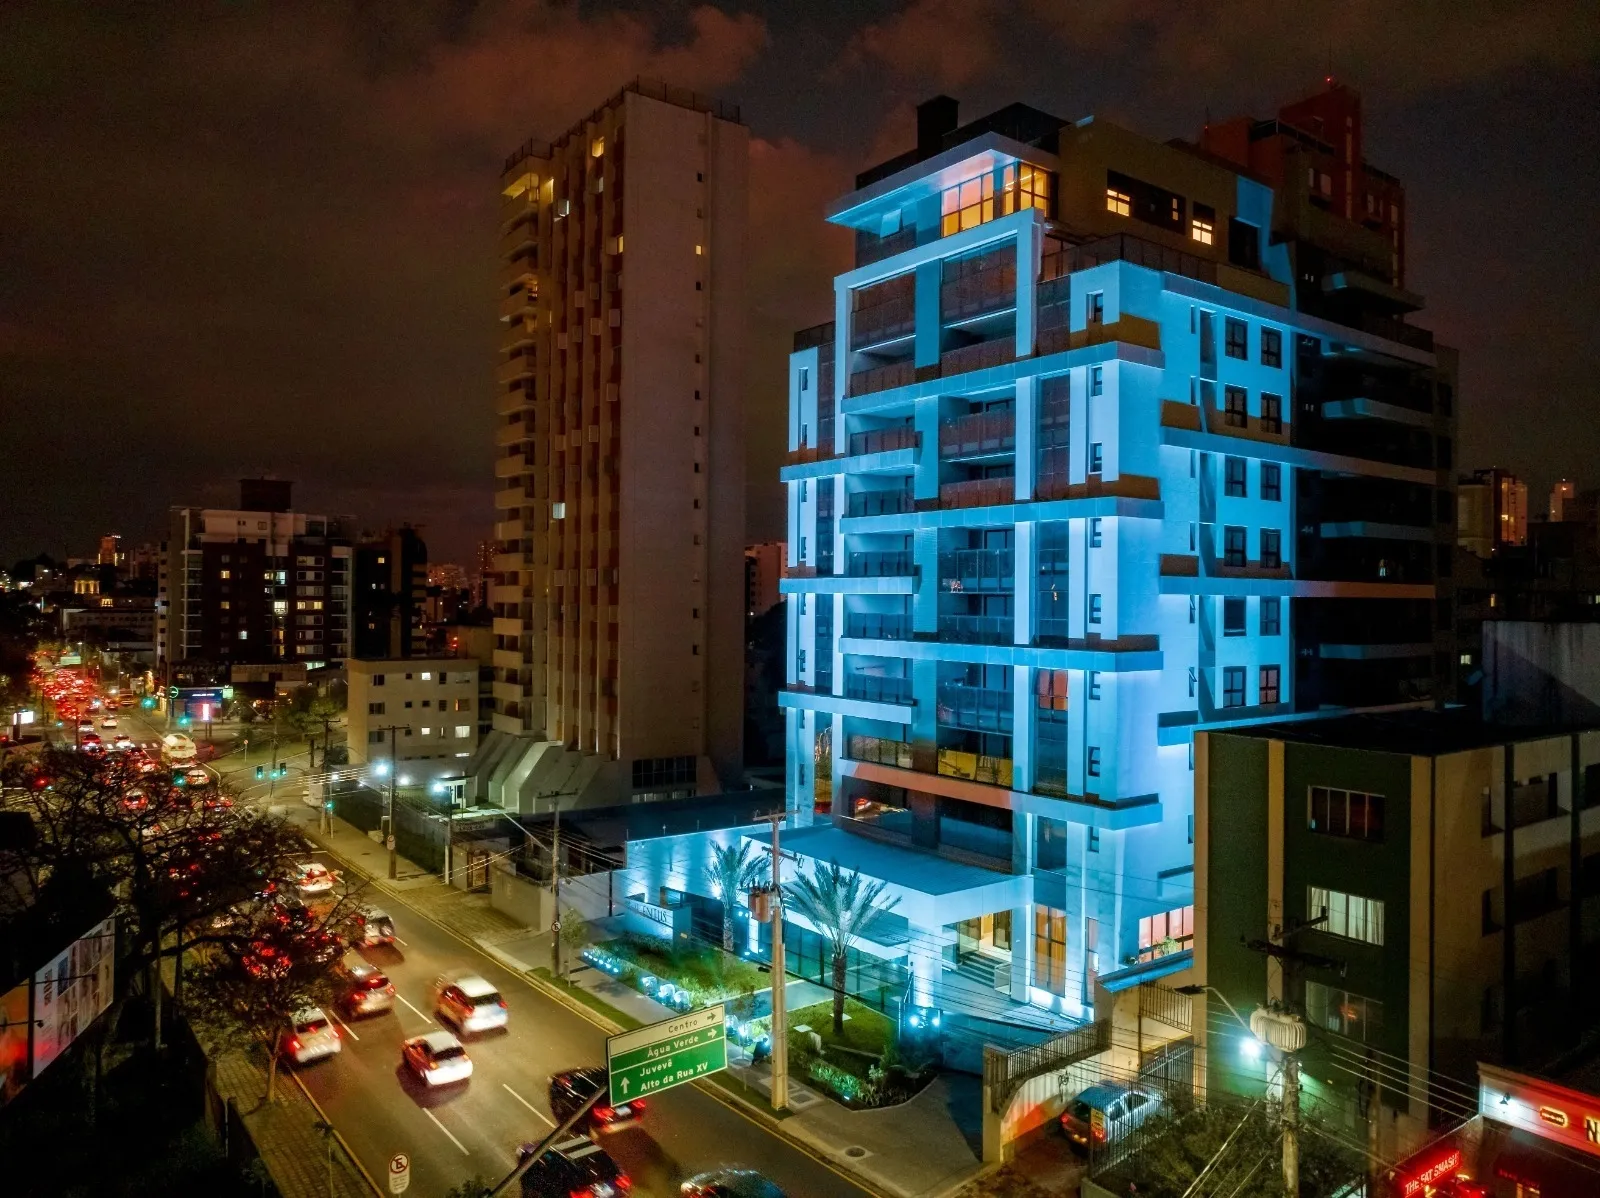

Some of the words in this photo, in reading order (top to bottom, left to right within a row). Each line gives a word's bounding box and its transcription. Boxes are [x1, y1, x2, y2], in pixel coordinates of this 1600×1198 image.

[668, 1019, 698, 1033] Centro
[647, 1045, 670, 1058] Água
[673, 1035, 699, 1049] Verde
[639, 1059, 673, 1077] Juvevê
[640, 1080, 660, 1092] Alto
[663, 1075, 674, 1084] da
[676, 1069, 694, 1079] Rua
[696, 1062, 709, 1073] XV
[1404, 1179, 1420, 1195] THE
